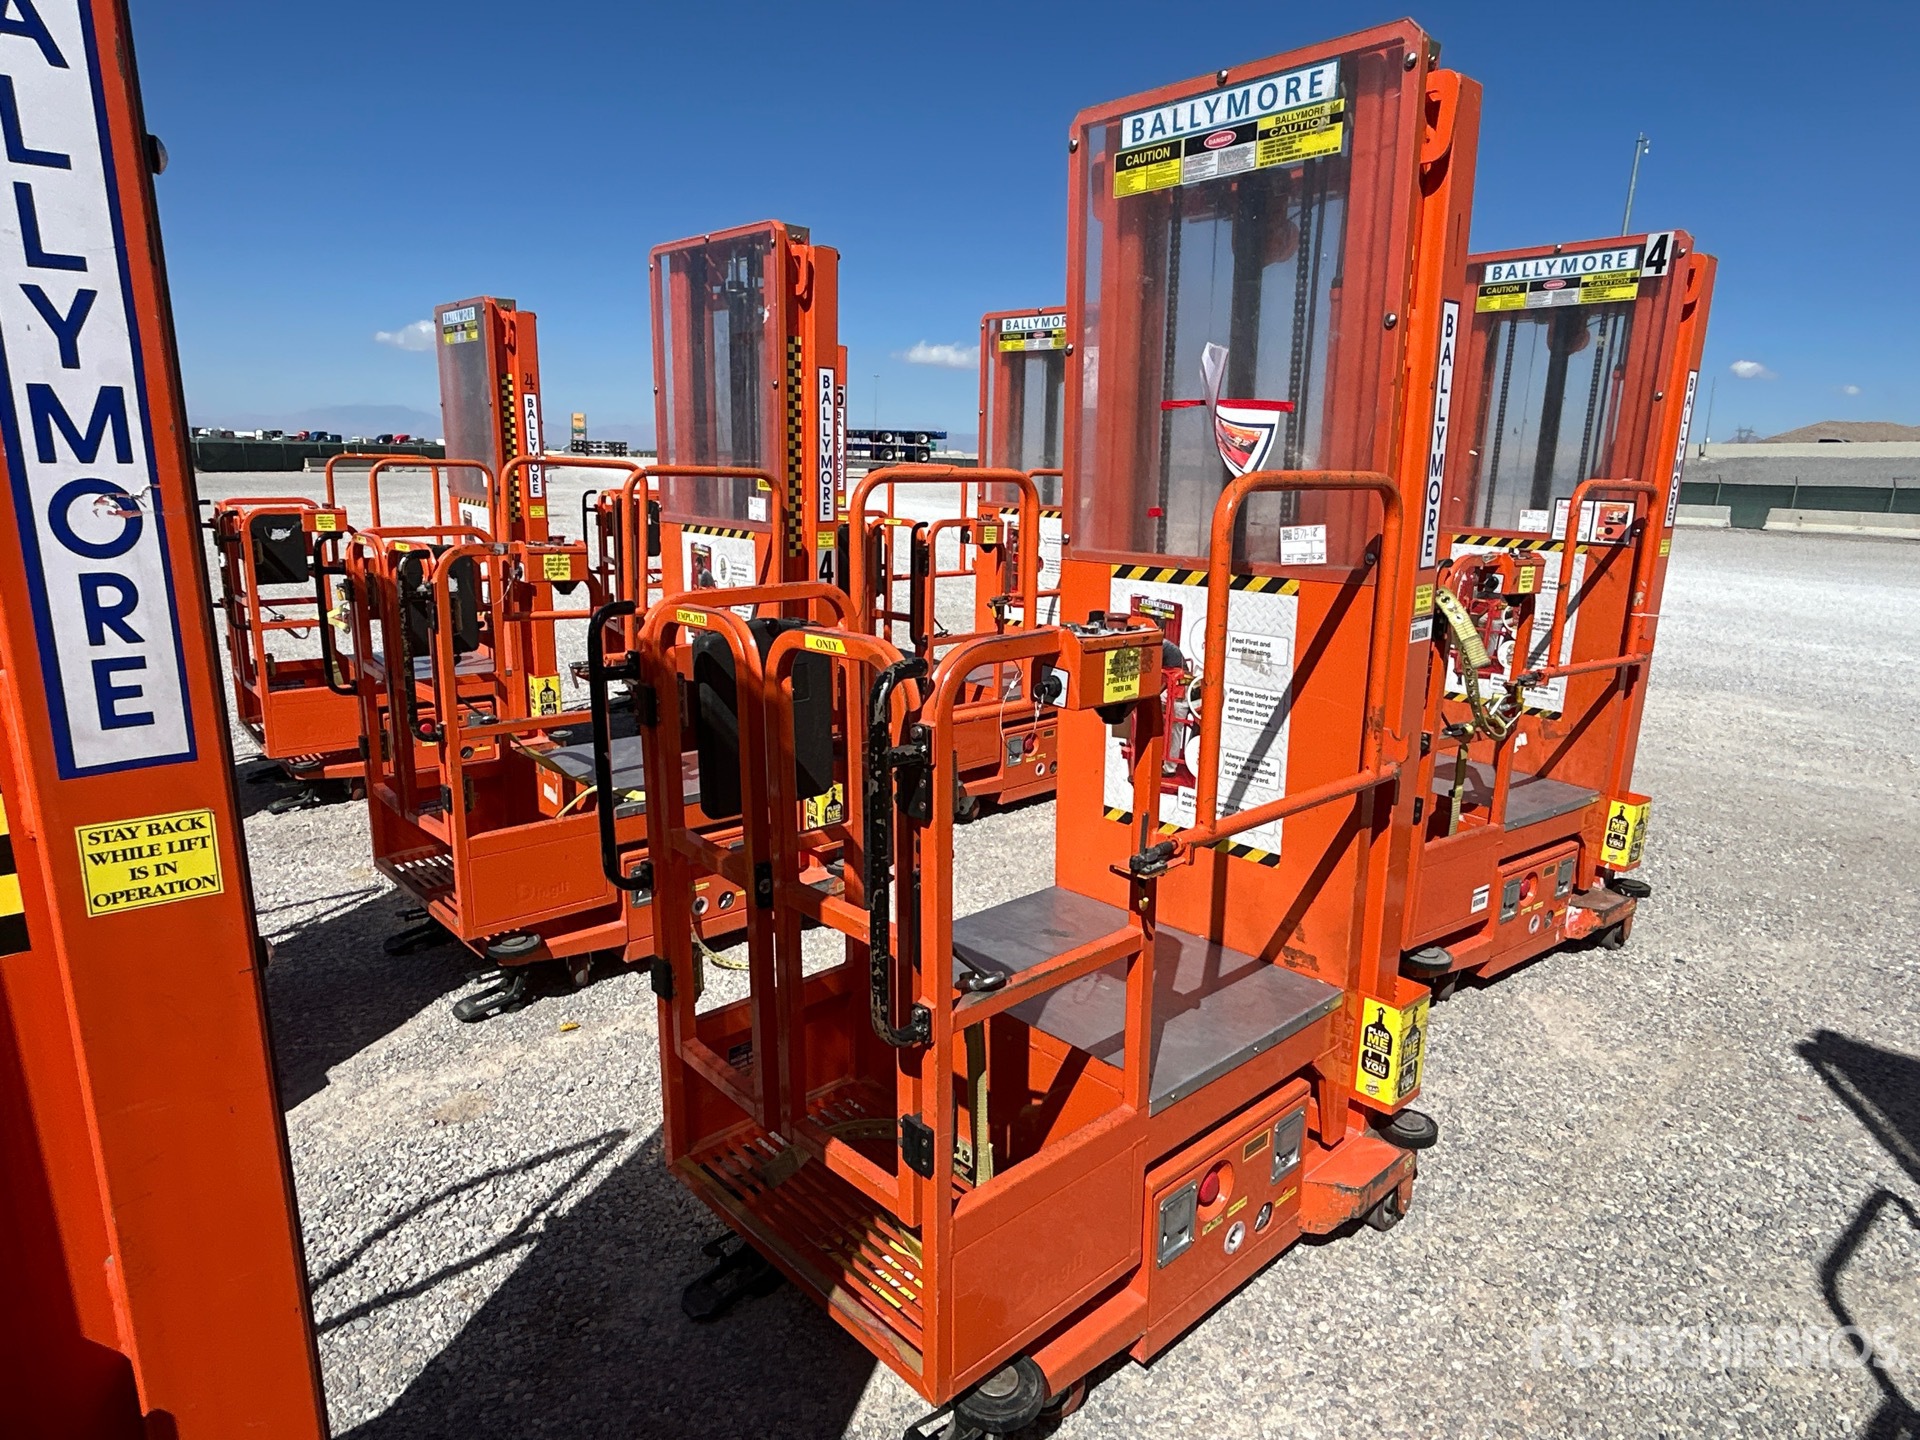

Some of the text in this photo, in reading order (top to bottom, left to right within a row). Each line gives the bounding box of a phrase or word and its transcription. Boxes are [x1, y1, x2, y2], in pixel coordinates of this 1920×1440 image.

[1132, 69, 1324, 143] BALLYMORE
[1269, 115, 1331, 137] CAUTION
[1207, 133, 1233, 146] DANGER
[1125, 146, 1171, 167] CAUTION
[1645, 234, 1669, 274] 4
[1492, 251, 1628, 281] BALLYMORE
[1486, 285, 1520, 295] CAUTION
[1588, 279, 1631, 287] CAUTION
[525, 373, 535, 390] 4
[1425, 313, 1454, 557] BALLYMORE
[821, 375, 835, 516] BALLYMORE
[1668, 378, 1694, 521] BALLYMORE
[819, 550, 835, 584] 4
[816, 637, 838, 651] ONLY
[1245, 638, 1258, 646] First
[1255, 692, 1269, 700] body
[1236, 706, 1254, 715] yellow
[1255, 709, 1269, 718] hook
[1240, 698, 1255, 706] static
[1256, 701, 1278, 711] lanyard
[1227, 714, 1242, 722] when
[1225, 752, 1245, 762] Always
[1224, 761, 1238, 769] body
[1252, 767, 1276, 777] attached
[88, 816, 207, 846] STAY BACK
[1611, 822, 1626, 832] ME
[87, 835, 210, 866] WHILE LIFT
[1608, 839, 1624, 848] YOU
[129, 861, 178, 881] IS IN
[93, 875, 217, 907] OPERATION
[1367, 1025, 1390, 1041] PLUG
[1367, 1033, 1389, 1050] ME
[1364, 1059, 1386, 1075] YOU
